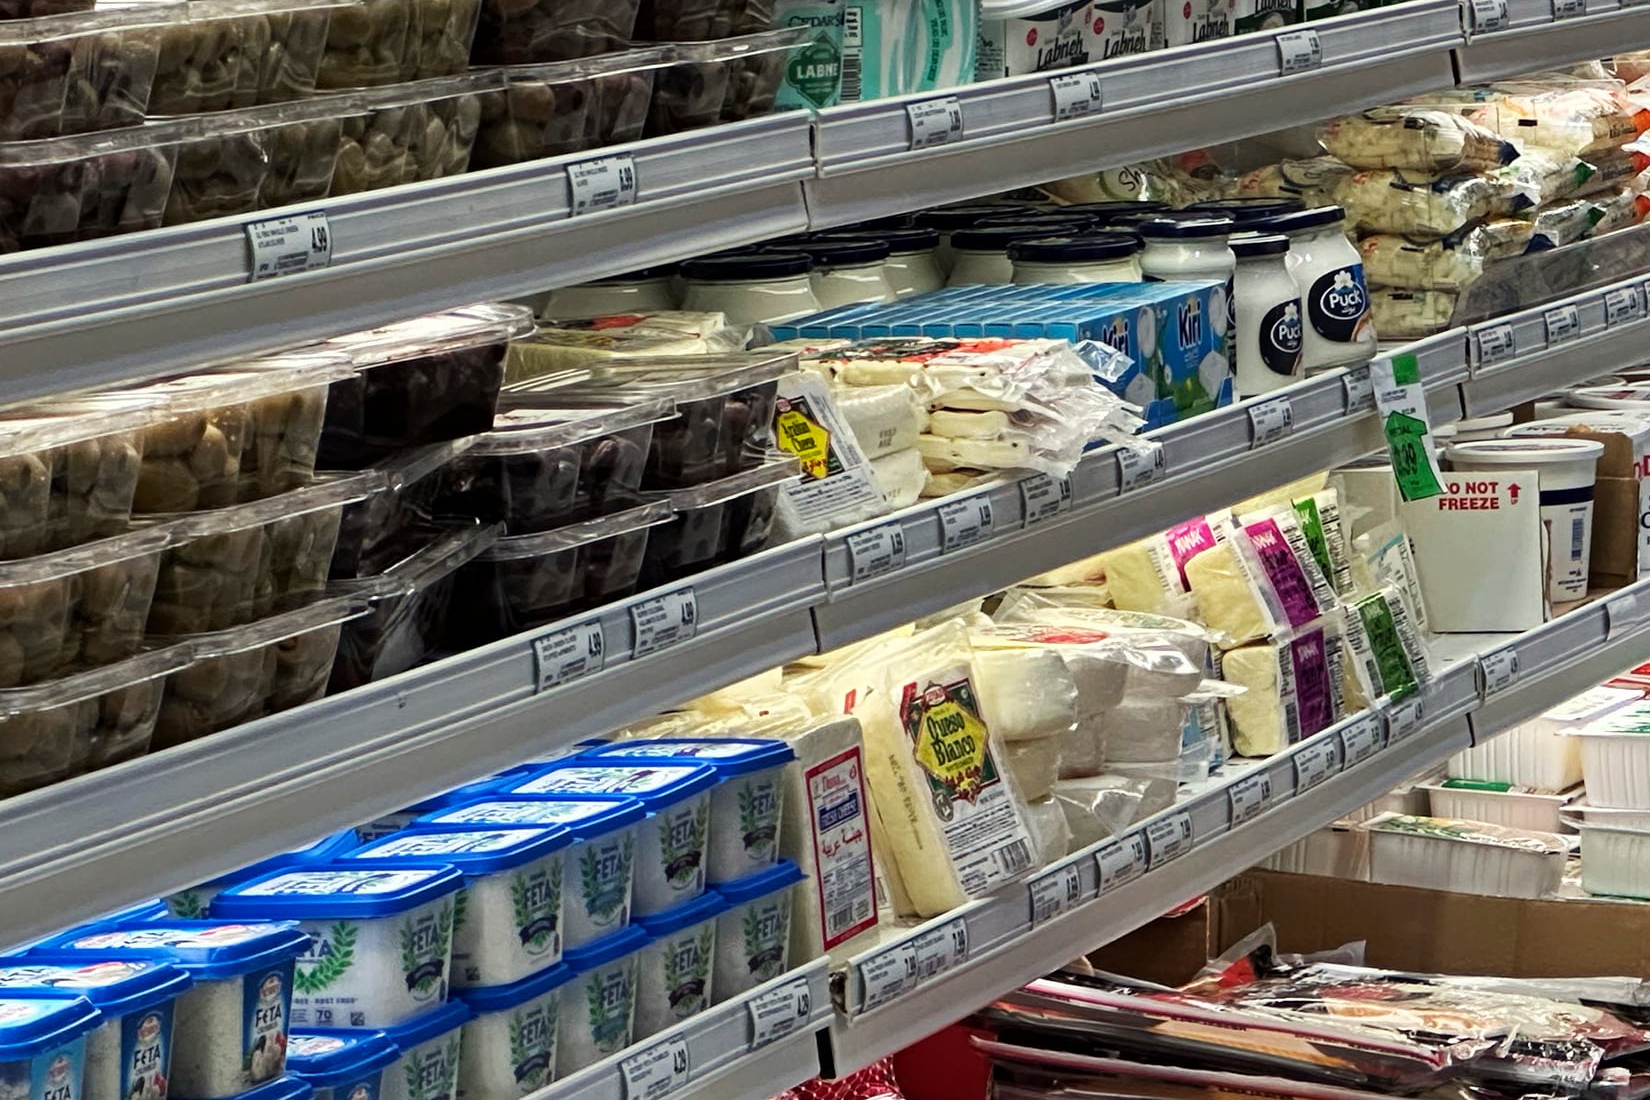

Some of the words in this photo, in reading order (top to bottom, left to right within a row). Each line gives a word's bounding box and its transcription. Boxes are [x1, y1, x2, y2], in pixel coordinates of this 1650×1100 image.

[796, 62, 839, 79] LABNE
[311, 225, 328, 254] 4.99
[1329, 289, 1362, 310] Puck
[1178, 297, 1202, 352] Kiri
[1465, 481, 1499, 495] NOT
[1438, 496, 1500, 511] FREEZE
[680, 600, 695, 627] 4.99
[667, 818, 697, 844] FETA
[524, 878, 553, 906] FETA
[410, 924, 441, 955] FETA
[255, 1005, 283, 1029] FETA
[316, 1011, 333, 1020] 70
[133, 1045, 161, 1070] FETA
[416, 1060, 447, 1092] FETA
